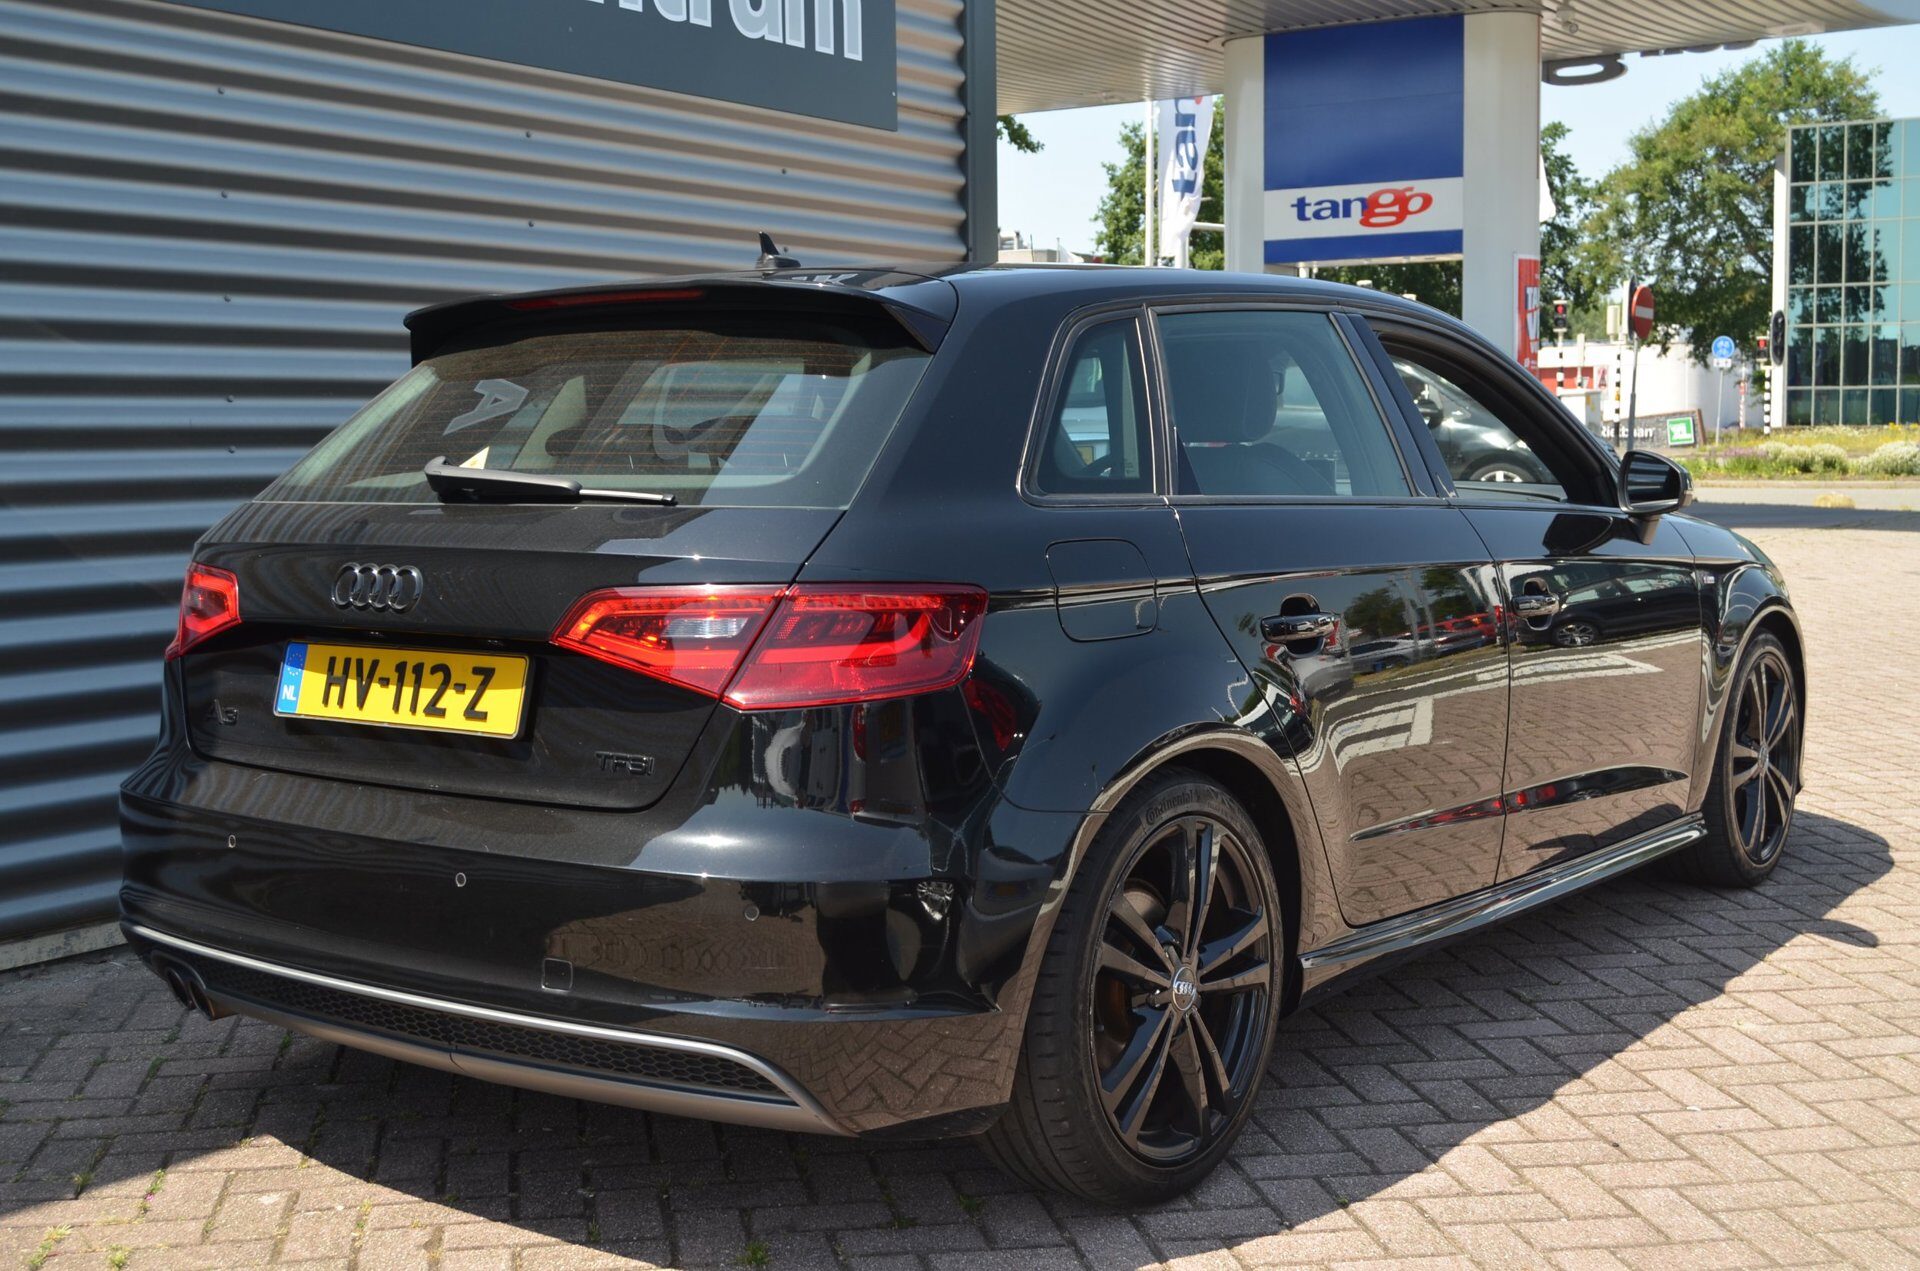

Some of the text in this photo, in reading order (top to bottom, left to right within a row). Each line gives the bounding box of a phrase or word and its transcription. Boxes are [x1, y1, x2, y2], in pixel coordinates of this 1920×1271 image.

[1172, 96, 1202, 202] tan
[1290, 186, 1434, 228] tango
[281, 684, 297, 701] NL
[322, 656, 496, 721] HV-112-Z
[595, 750, 655, 775] TFSI
